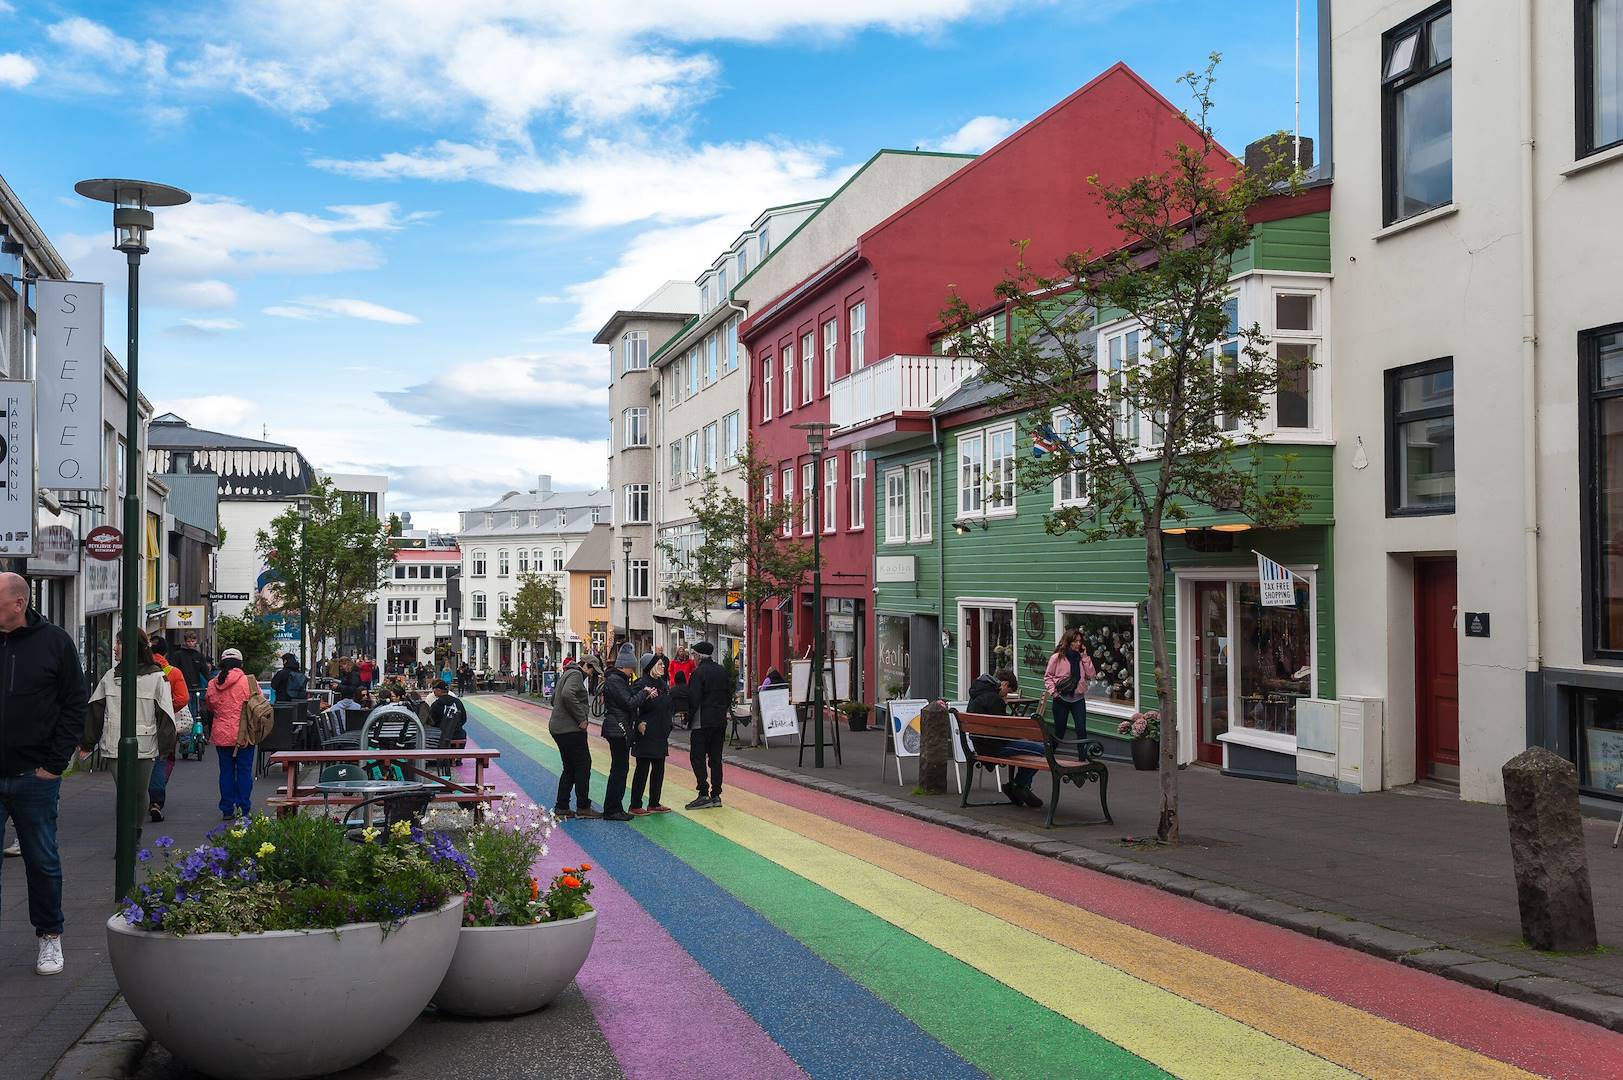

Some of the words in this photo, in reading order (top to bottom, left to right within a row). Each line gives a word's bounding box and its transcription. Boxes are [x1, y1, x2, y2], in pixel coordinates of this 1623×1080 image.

[1264, 582, 1274, 590] TAX
[1276, 582, 1289, 590] FREE
[1264, 591, 1290, 599] SHOPPING
[879, 643, 910, 668] Kaolin
